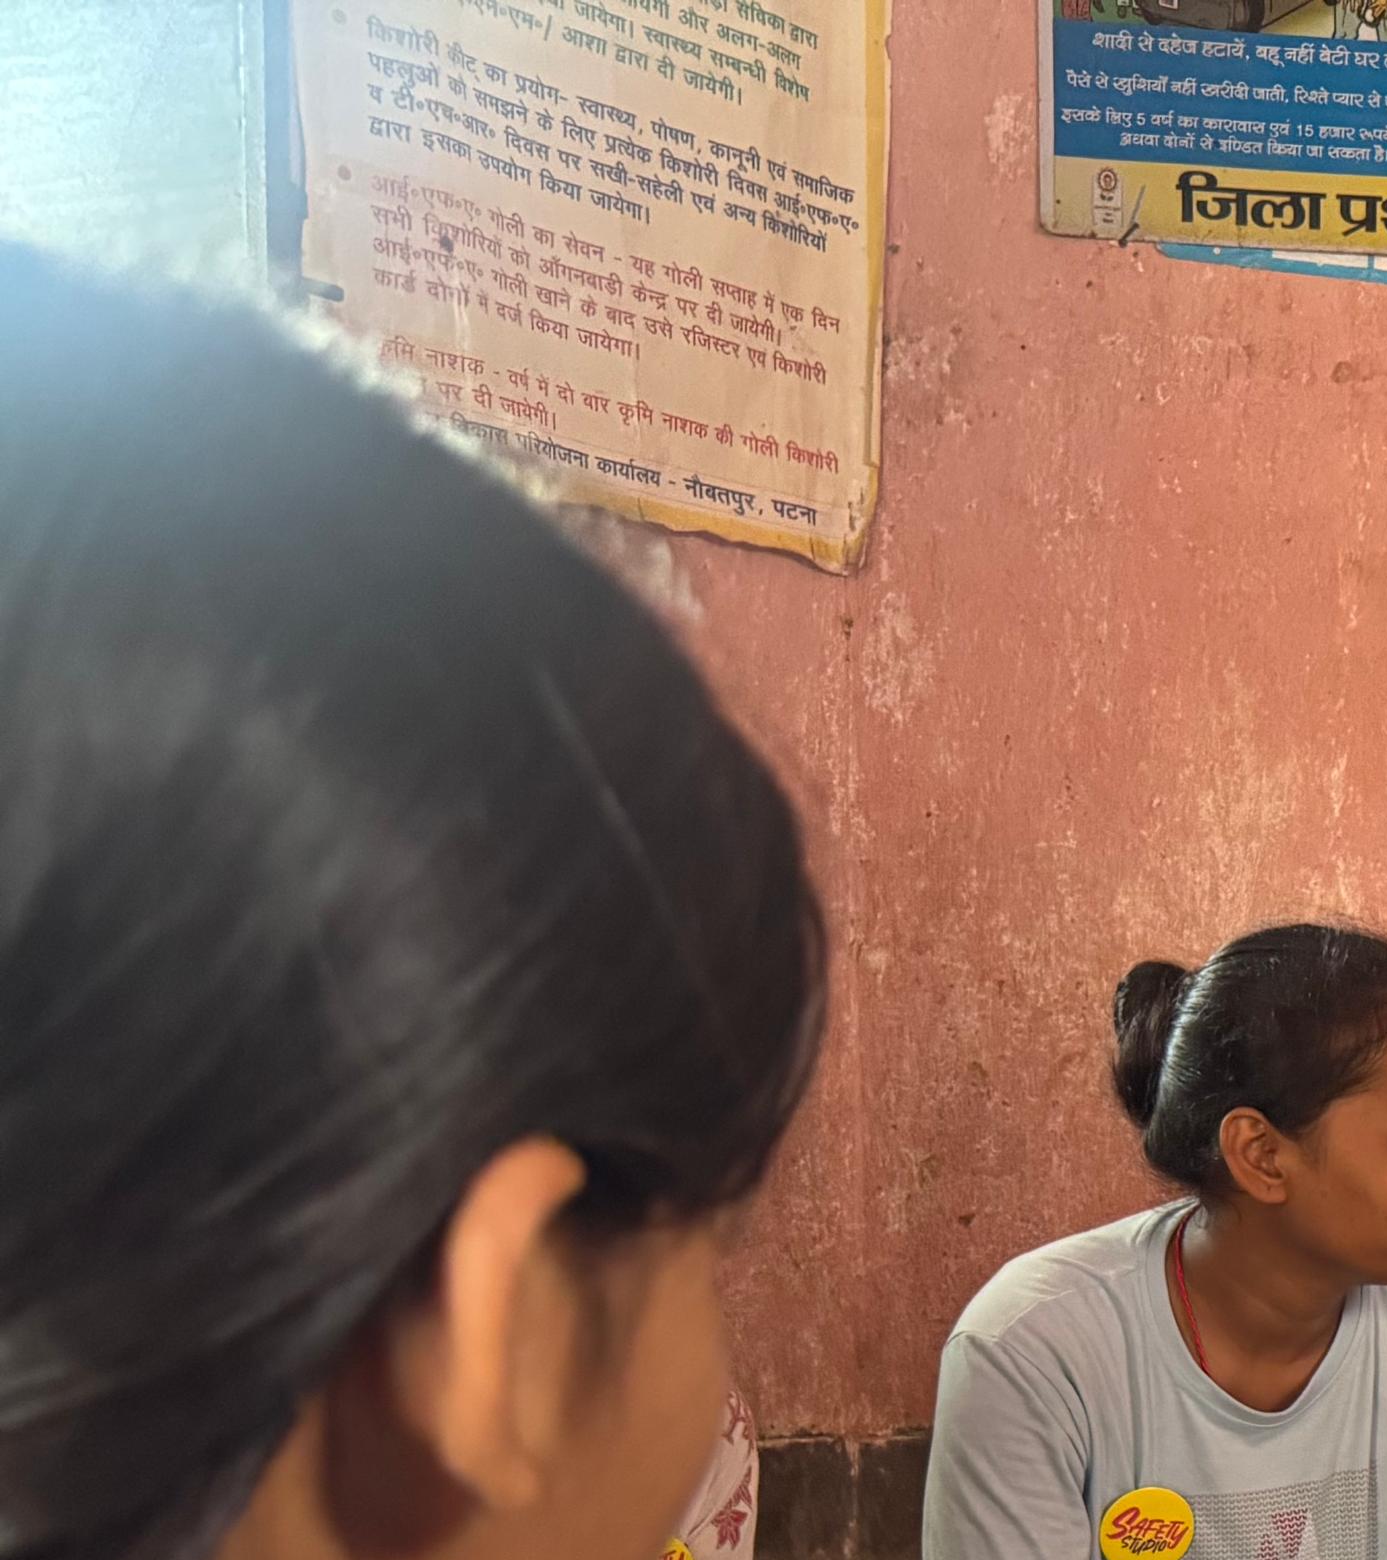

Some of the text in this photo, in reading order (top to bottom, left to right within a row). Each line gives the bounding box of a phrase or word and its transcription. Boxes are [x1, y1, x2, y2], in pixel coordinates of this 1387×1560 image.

[640, 23, 705, 63] स्वास्थ्य
[678, 7, 801, 71] और अलग-अलग
[1092, 29, 1379, 68] शादी से दहेज बहू नहीं बेटी घर
[614, 43, 741, 106] द्वारा दी जायेगी।
[1095, 71, 1109, 88] से
[1170, 77, 1196, 95] नहीं
[1200, 80, 1249, 99] खरीदी
[1331, 92, 1364, 107] प्यार
[1367, 89, 1381, 107] से
[473, 87, 767, 202] समझने के लिए प्रत्येक किशोरी दिवस
[1060, 105, 1101, 123] इसके
[1105, 106, 1132, 127] लिए
[1136, 112, 1145, 125] 5
[1150, 110, 1173, 127] वर्ष
[1176, 115, 1198, 127] का
[1202, 117, 1265, 133] कारावास
[1296, 123, 1314, 137] 15
[1319, 125, 1355, 140] हजार
[1120, 131, 1371, 160] अथवा दोनों सकता
[368, 115, 649, 225] द्वारा उपयोग किया जायेगा।
[504, 125, 684, 204] दिवस पर सखी-सहेली
[708, 139, 761, 173] कानूनी
[1175, 170, 1326, 229] जिला
[532, 225, 840, 333] का सेवन यह गोली सप्ताह एक दिन
[529, 308, 639, 360] किया जायेगा।
[534, 284, 826, 384] खाने उसे रजिस्टर किशोरी
[631, 280, 781, 346] केन्द्र पर दी जायेगी।
[499, 395, 556, 430] जायेगी।
[661, 412, 838, 473] नाशक की गोली किशोरी
[596, 456, 817, 526] कार्यालय पटना
[1107, 1507, 1190, 1549] SAFETY
[1121, 1536, 1168, 1556] STUDIO
